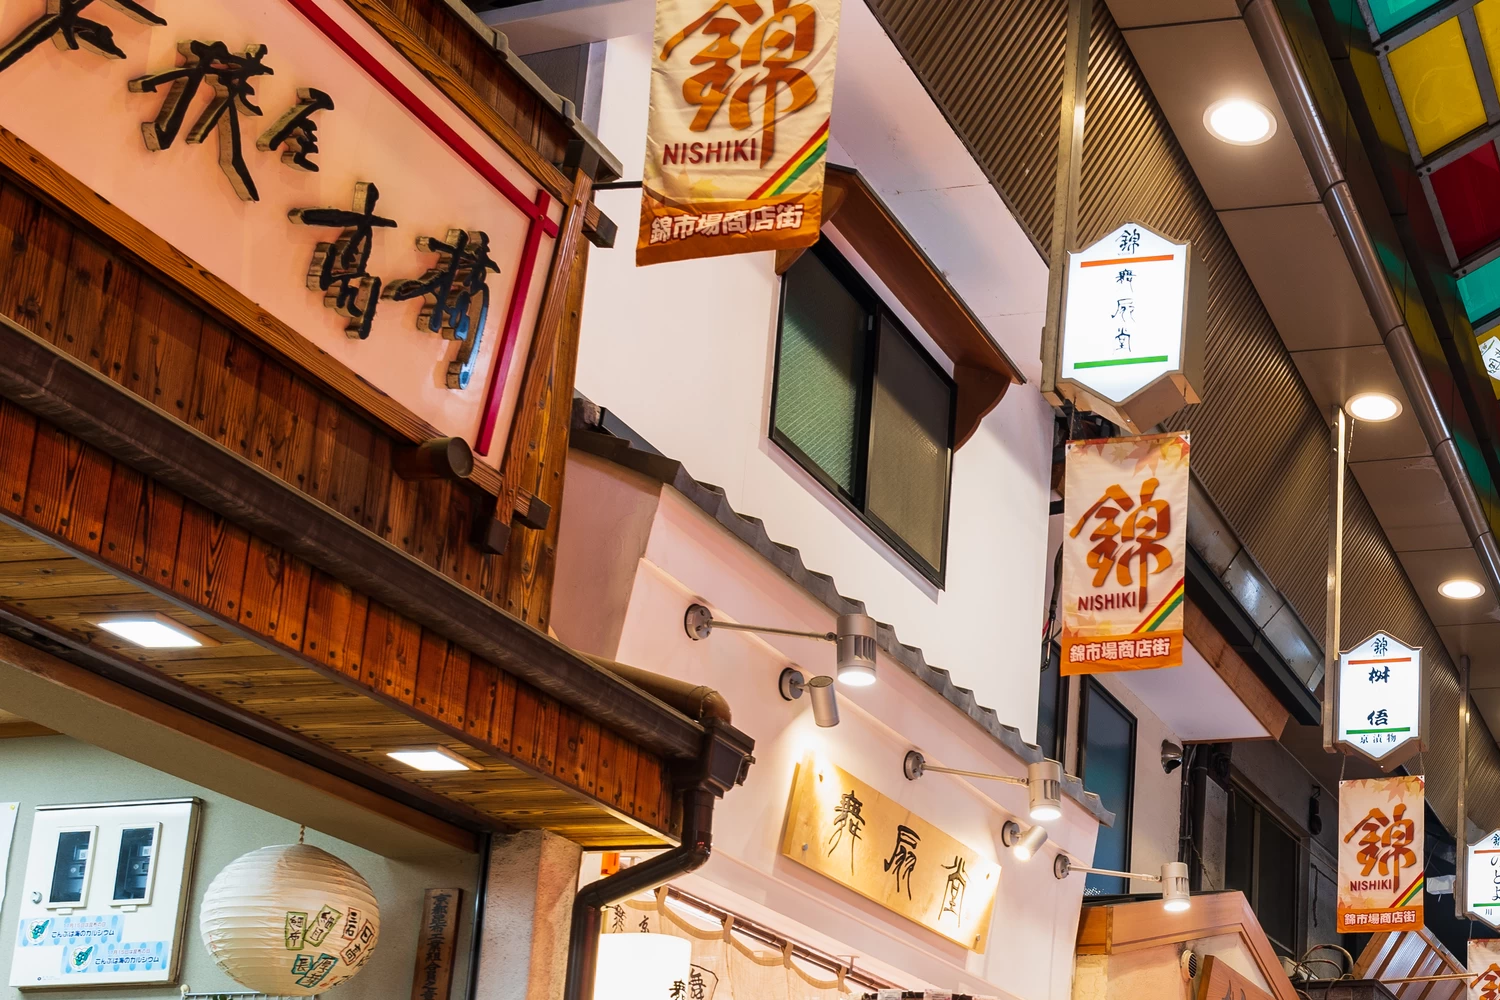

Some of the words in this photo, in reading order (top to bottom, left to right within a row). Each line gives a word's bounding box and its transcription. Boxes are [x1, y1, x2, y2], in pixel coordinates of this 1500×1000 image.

[659, 0, 818, 168] 錦
[662, 138, 758, 165] NISHIKI
[649, 203, 804, 245] 錦市場商店街
[1069, 477, 1173, 612] 錦
[1077, 591, 1137, 612] NISHIKI
[1069, 638, 1170, 662] 錦市場商店街
[1343, 803, 1416, 893] 錦
[1349, 878, 1392, 893] NISHIKI
[1344, 909, 1416, 926] 錦市場商店街
[51, 929, 115, 938] こんぶは海のカルシウム
[95, 956, 159, 965] こんぶは海のカルシウム
